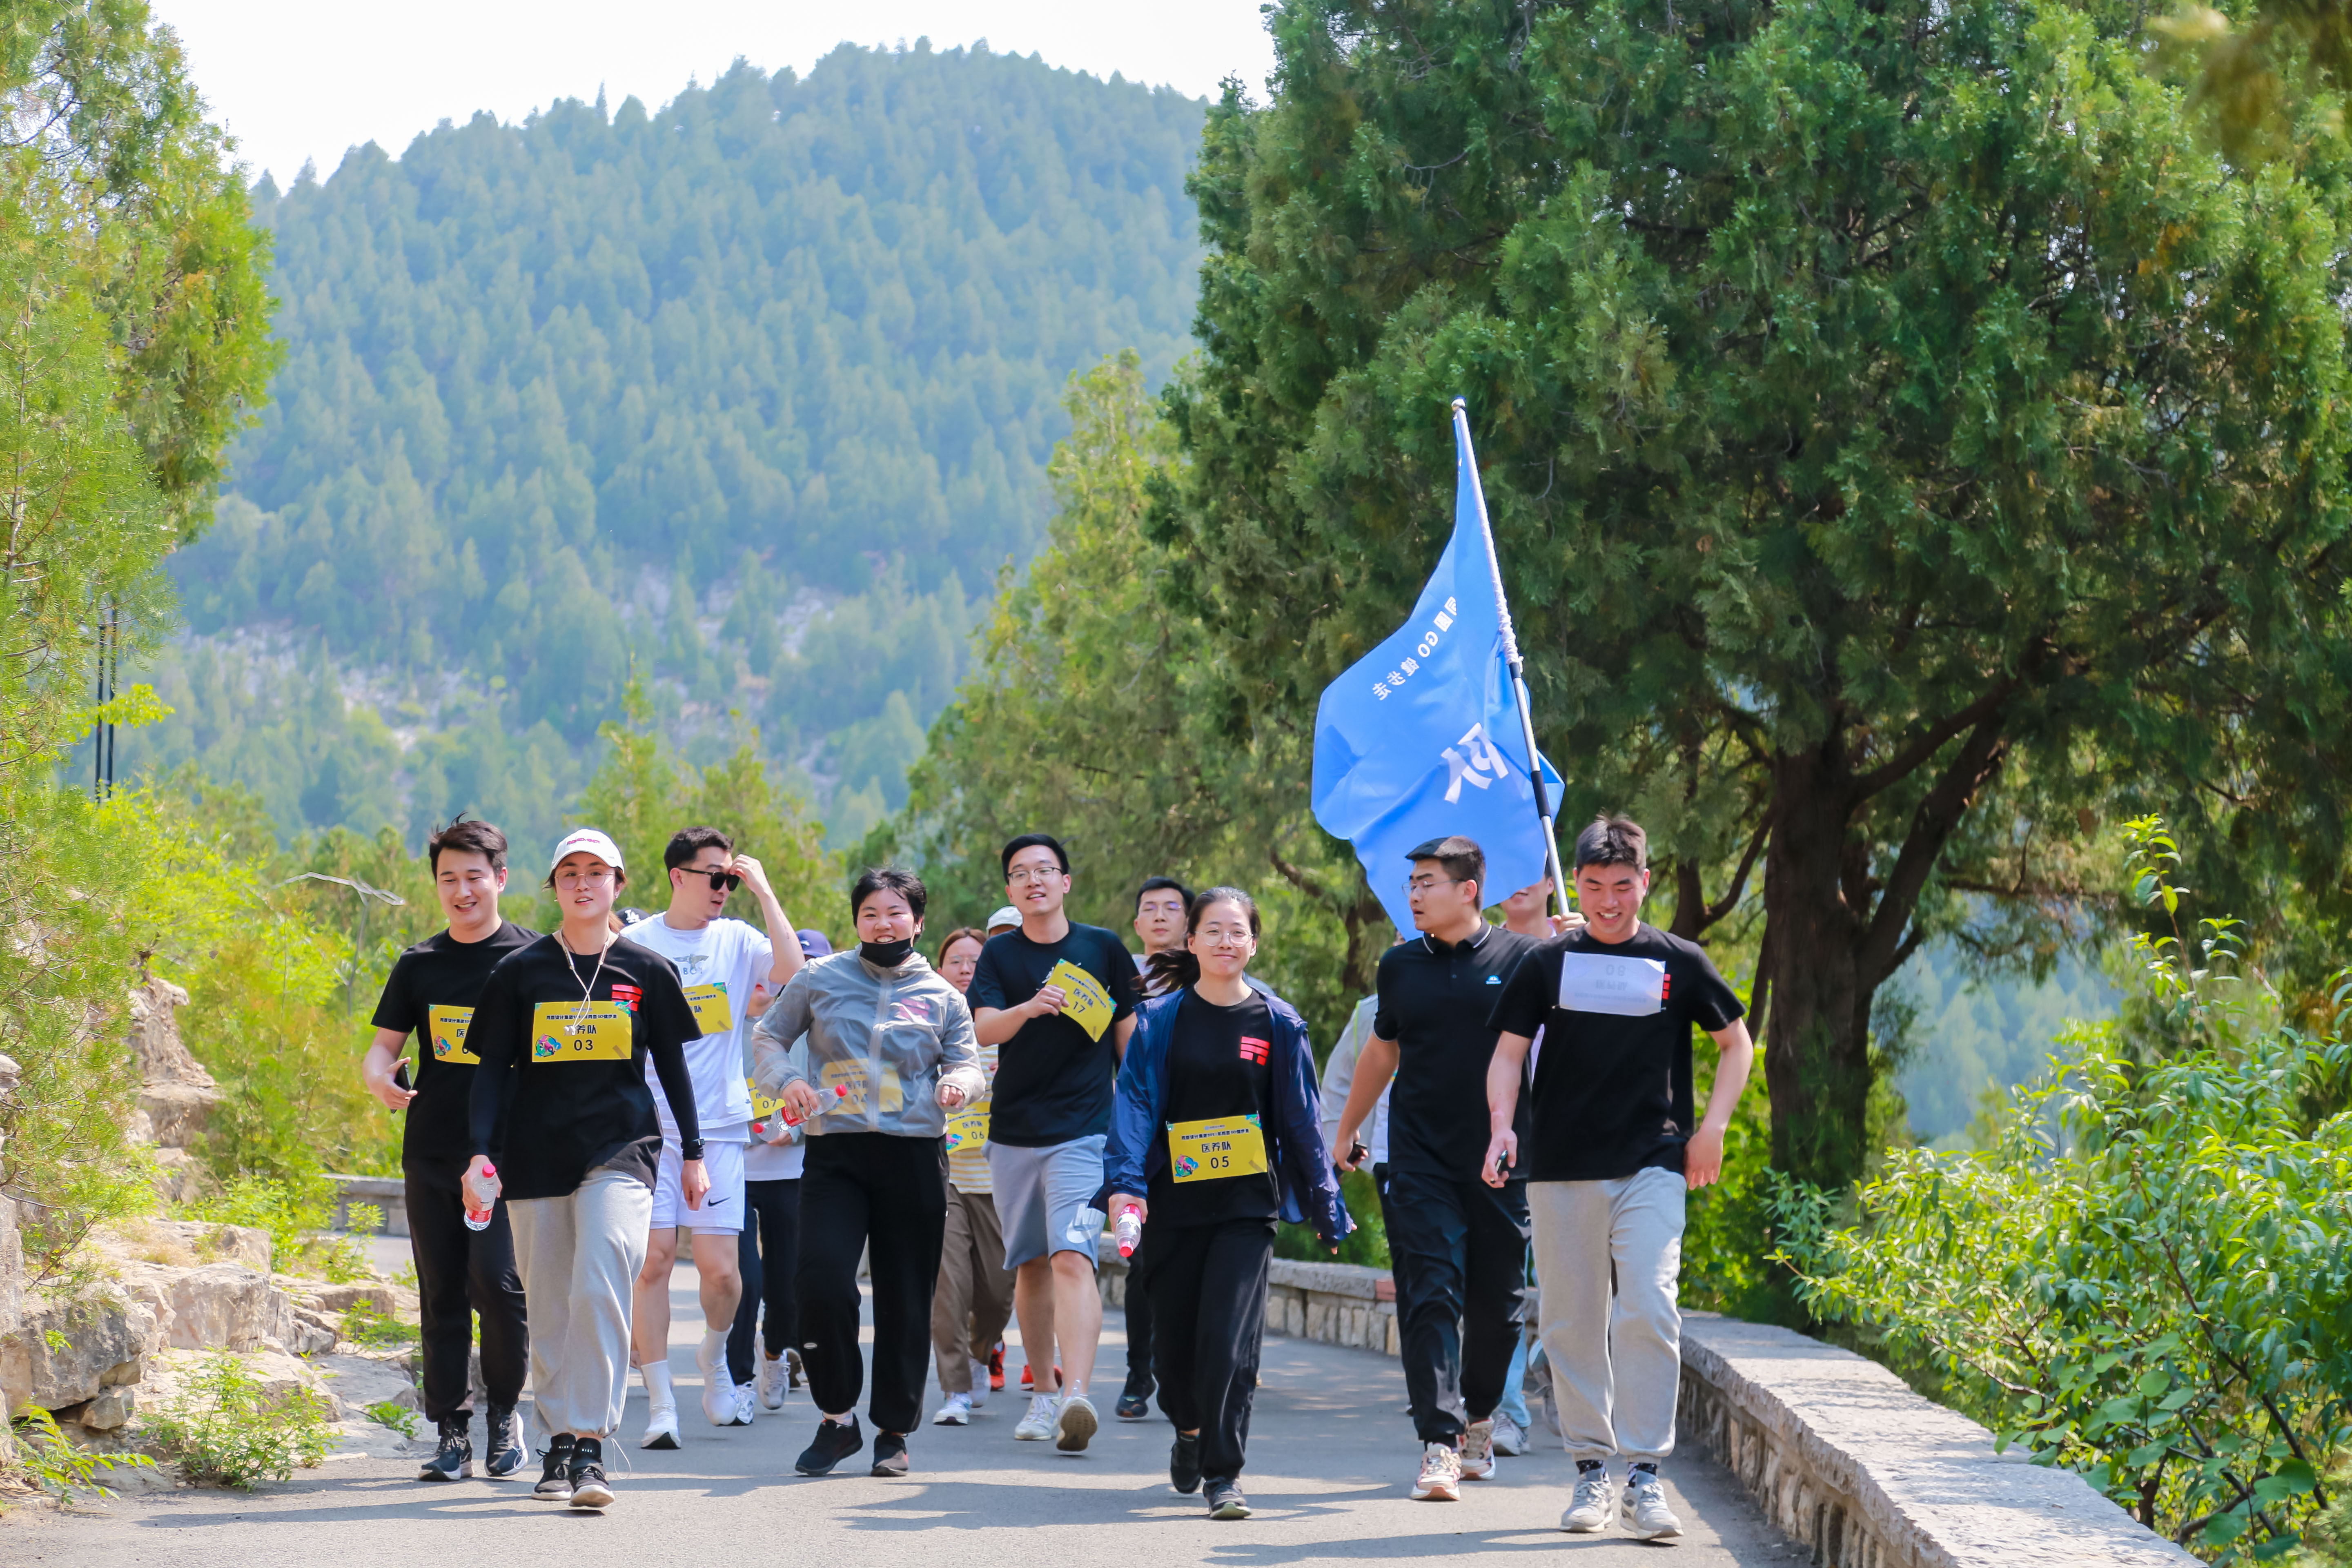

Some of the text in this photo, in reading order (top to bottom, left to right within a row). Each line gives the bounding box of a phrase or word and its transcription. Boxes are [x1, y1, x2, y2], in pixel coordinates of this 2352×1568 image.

[1073, 1001, 1086, 1013] 17
[574, 1039, 593, 1051] 03
[763, 1099, 776, 1109] 07
[971, 1131, 984, 1139] 06
[1201, 1141, 1231, 1153] 医养队
[1211, 1156, 1229, 1169] 05
